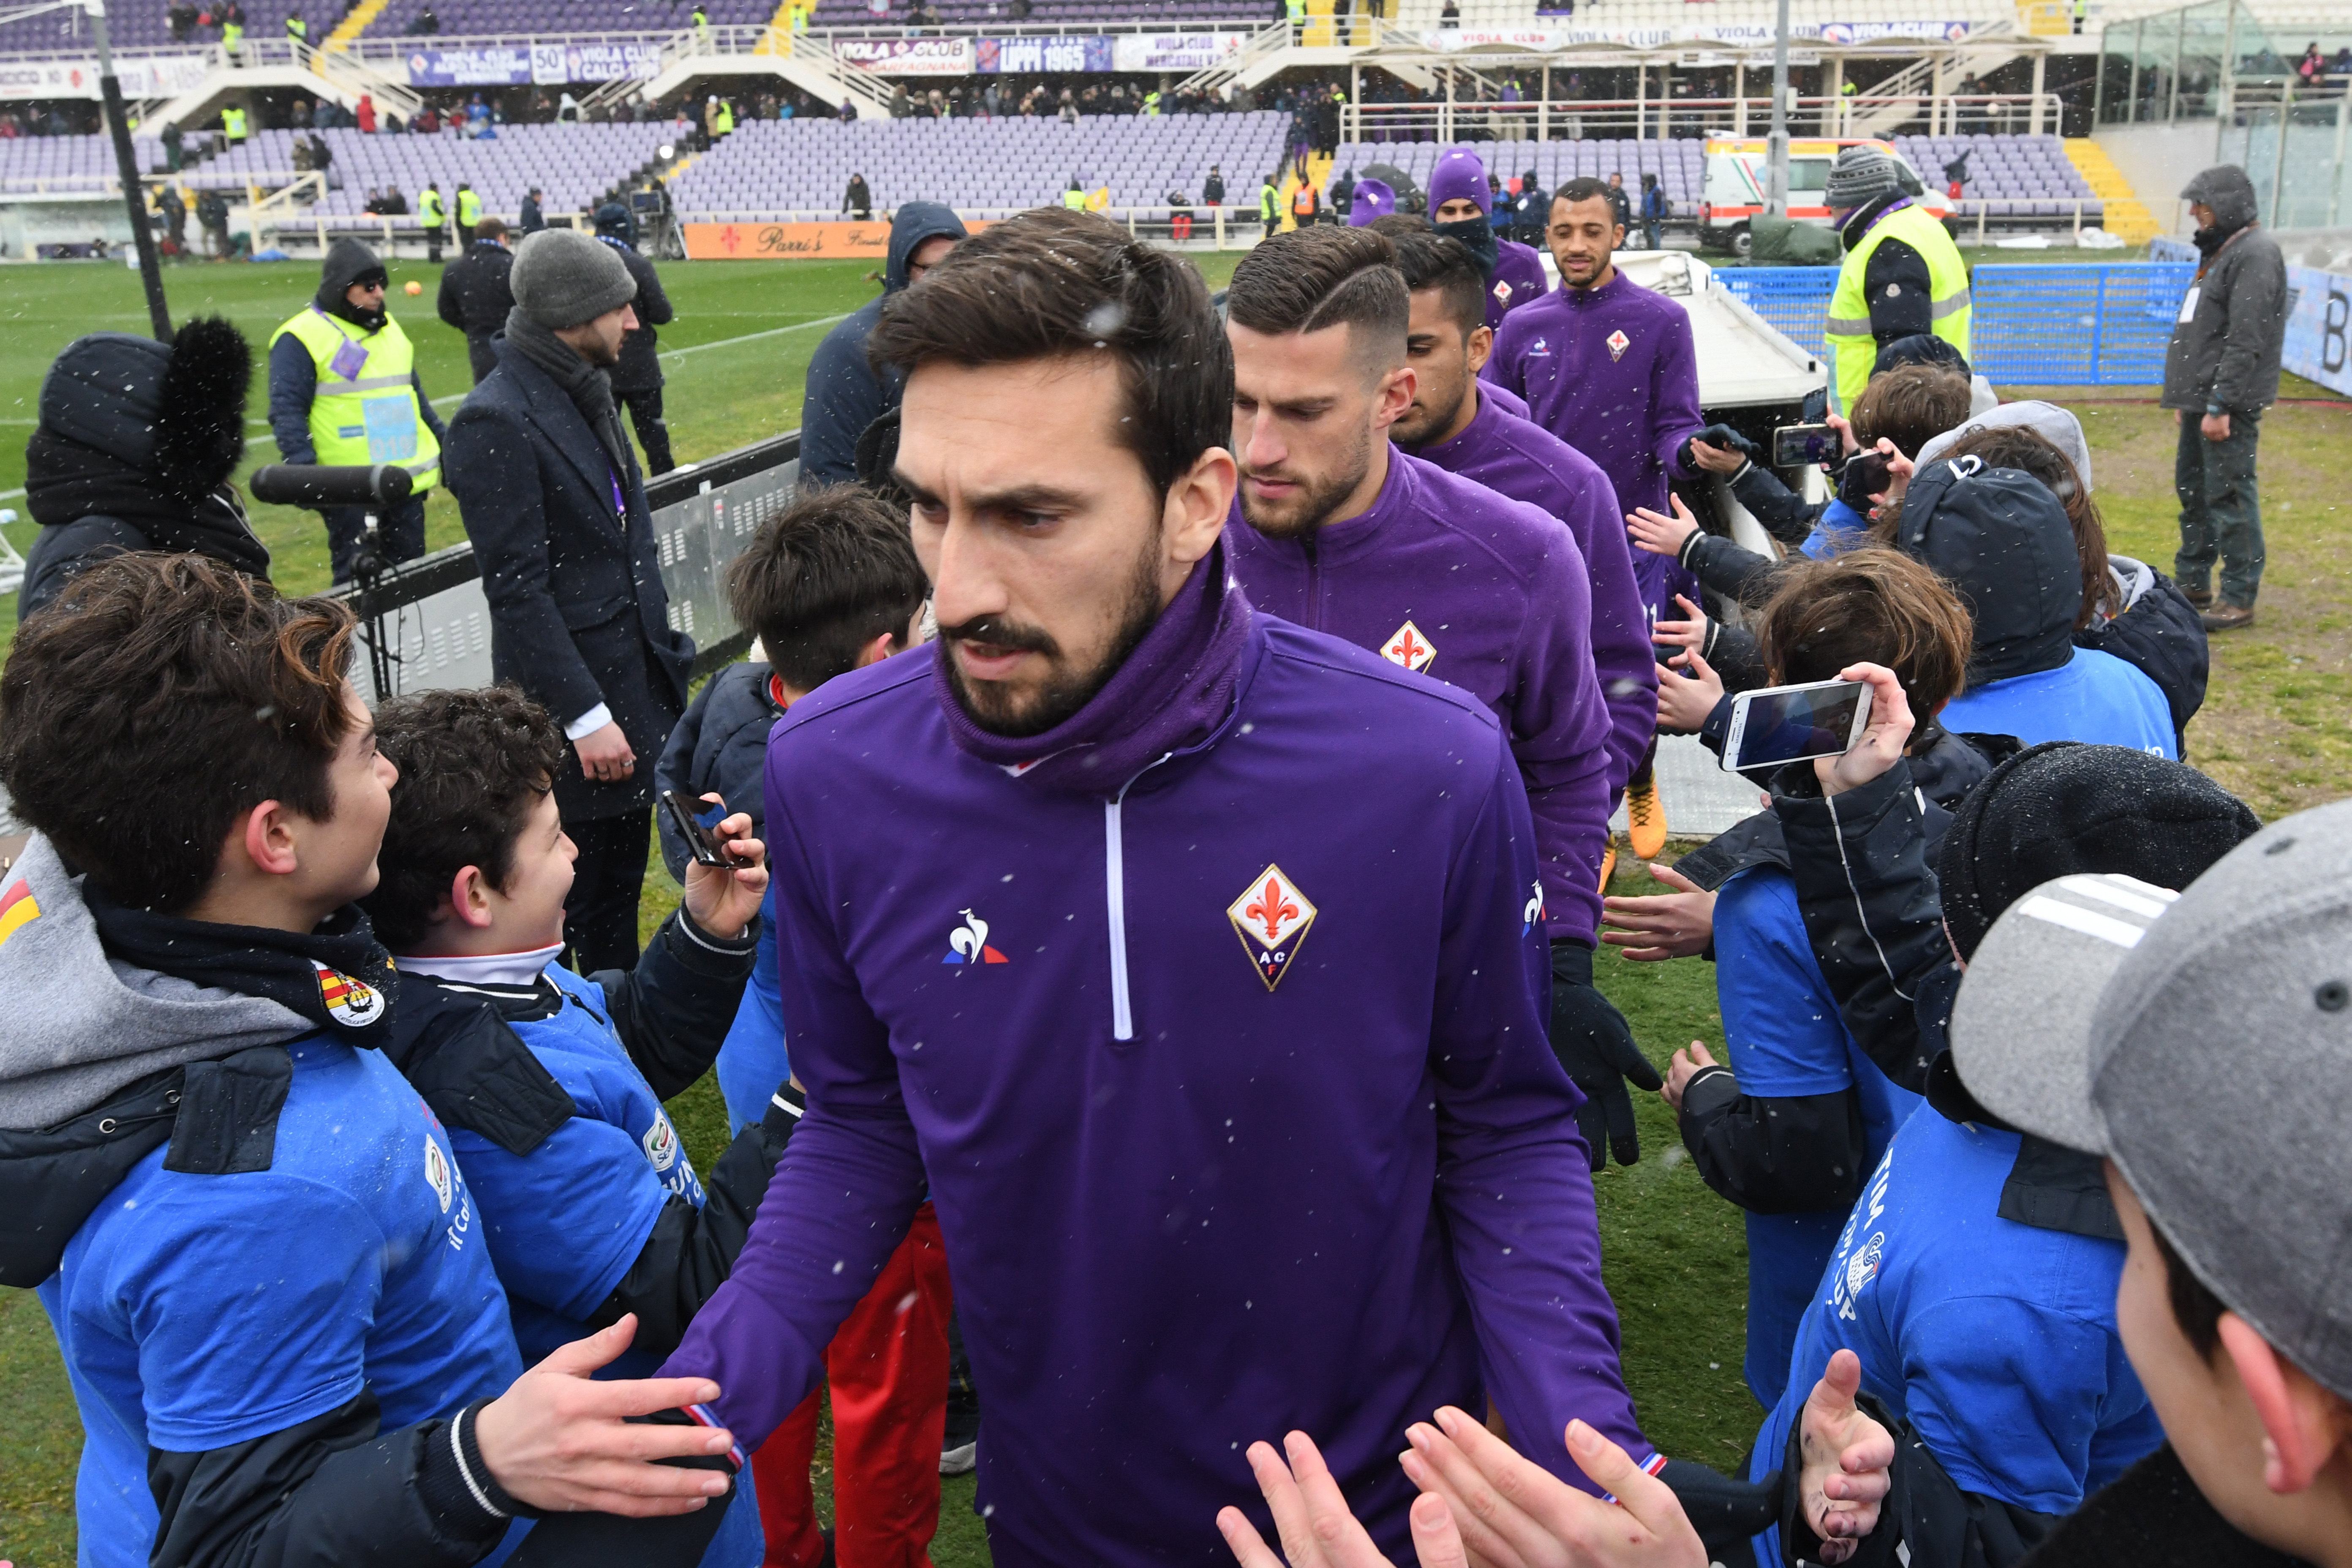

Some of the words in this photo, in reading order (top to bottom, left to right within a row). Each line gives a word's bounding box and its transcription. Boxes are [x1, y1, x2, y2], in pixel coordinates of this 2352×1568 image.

[1462, 34, 1502, 42] VIOLA
[1514, 33, 1545, 42] CLUB
[1629, 30, 1671, 44] CLUB
[1715, 27, 1766, 38] VIOLA
[835, 42, 890, 60] VIOLA
[914, 41, 963, 56] CLUB
[1188, 37, 1213, 49] CLUB
[581, 46, 622, 62] VIOLA
[1000, 46, 1041, 72] LIPPI
[1043, 45, 1085, 72] 1965
[757, 226, 823, 252] Parri's
[1268, 964, 1277, 976] F
[1863, 1147, 1894, 1232] TIM
